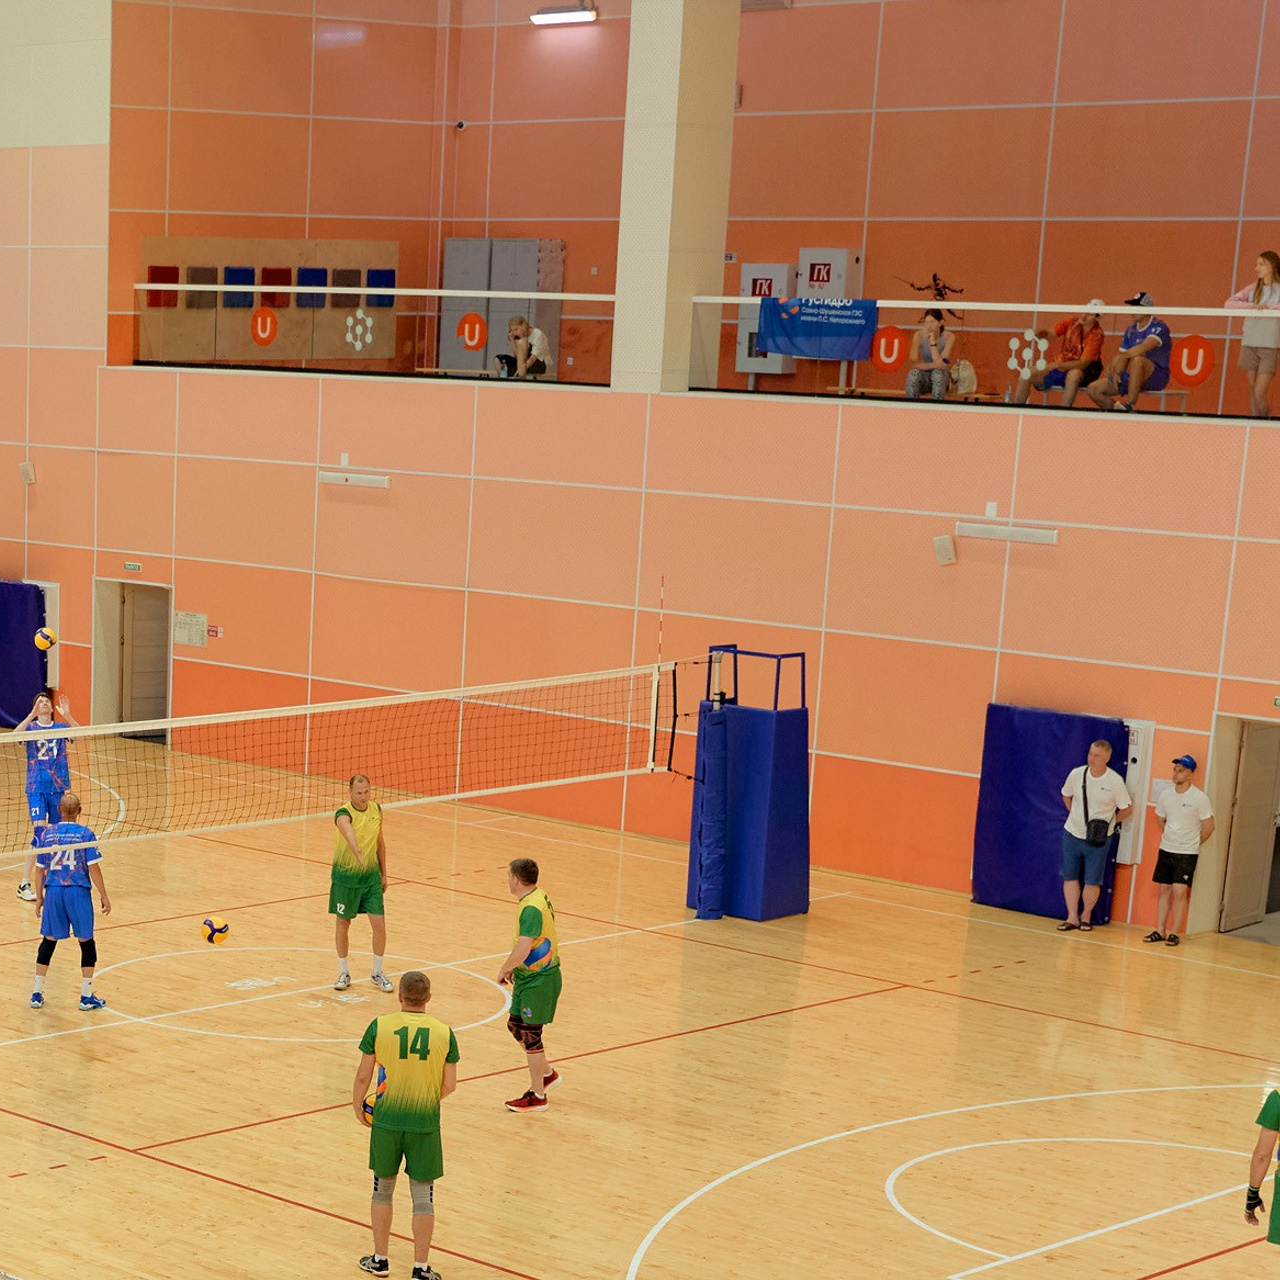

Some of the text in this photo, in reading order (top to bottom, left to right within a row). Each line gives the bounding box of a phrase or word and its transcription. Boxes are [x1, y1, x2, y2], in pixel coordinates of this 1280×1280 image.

[813, 264, 830, 281] ПК
[755, 279, 771, 295] ПК
[37, 739, 57, 760] 21
[31, 807, 39, 816] 21
[50, 845, 77, 870] 24
[337, 902, 345, 914] 12
[394, 1025, 430, 1061] 14
